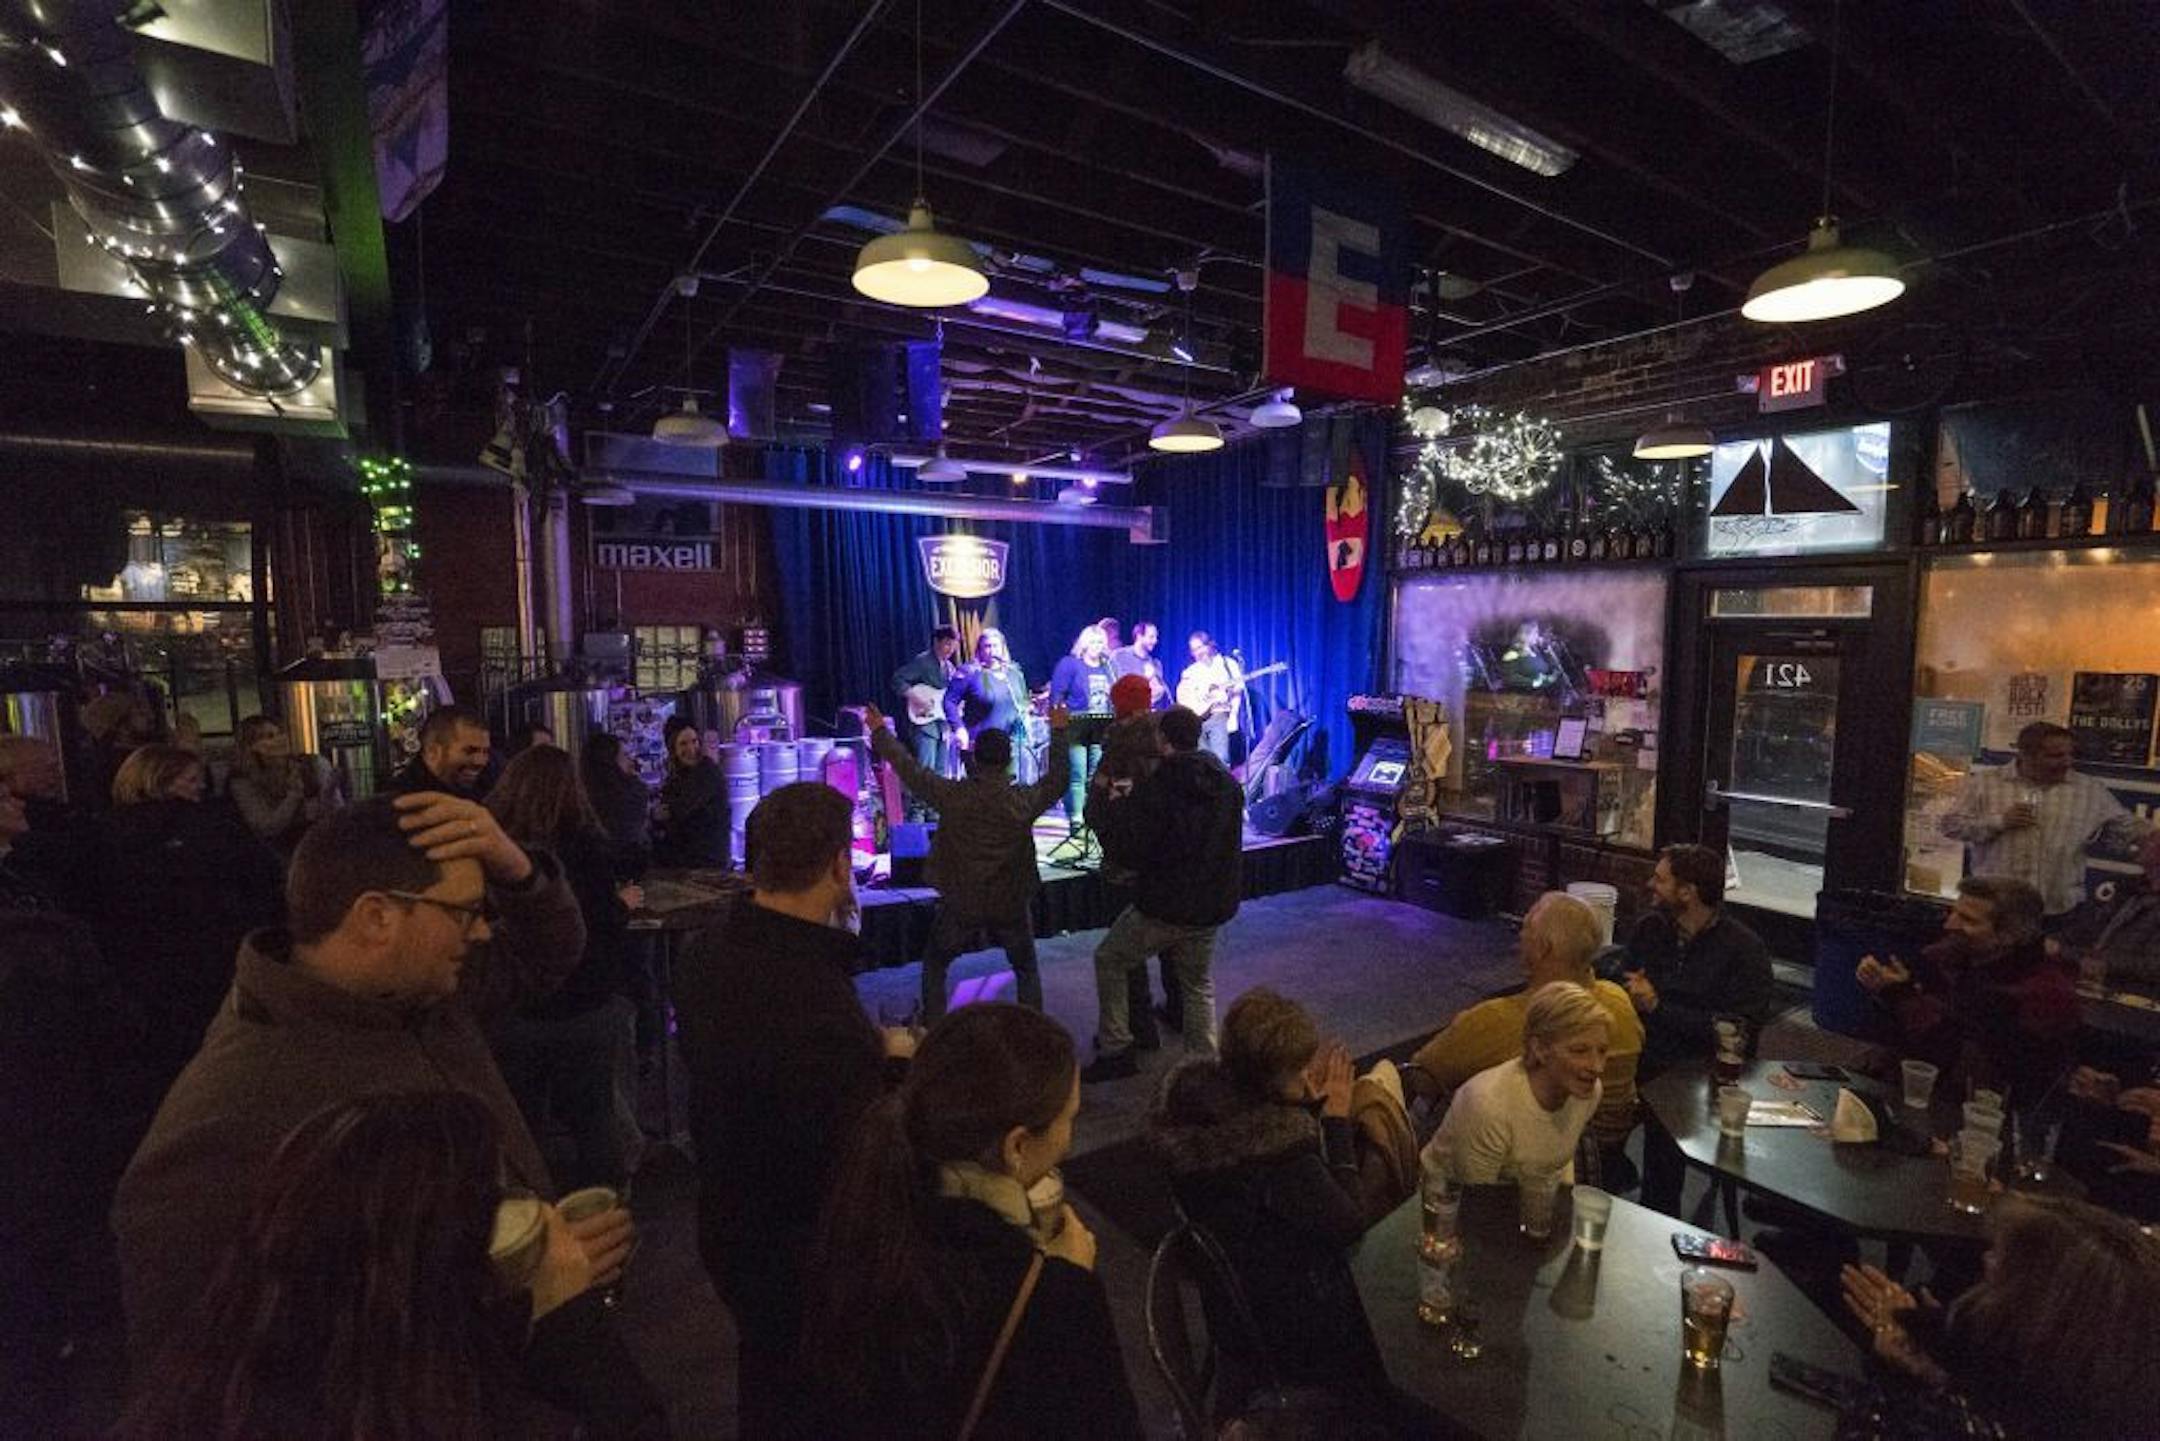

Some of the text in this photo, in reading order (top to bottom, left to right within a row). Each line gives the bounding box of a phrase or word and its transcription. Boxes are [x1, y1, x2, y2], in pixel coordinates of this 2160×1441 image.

[1771, 361, 1815, 397] EXIT
[598, 542, 712, 569] maxell
[930, 556, 1001, 581] EXCIOR
